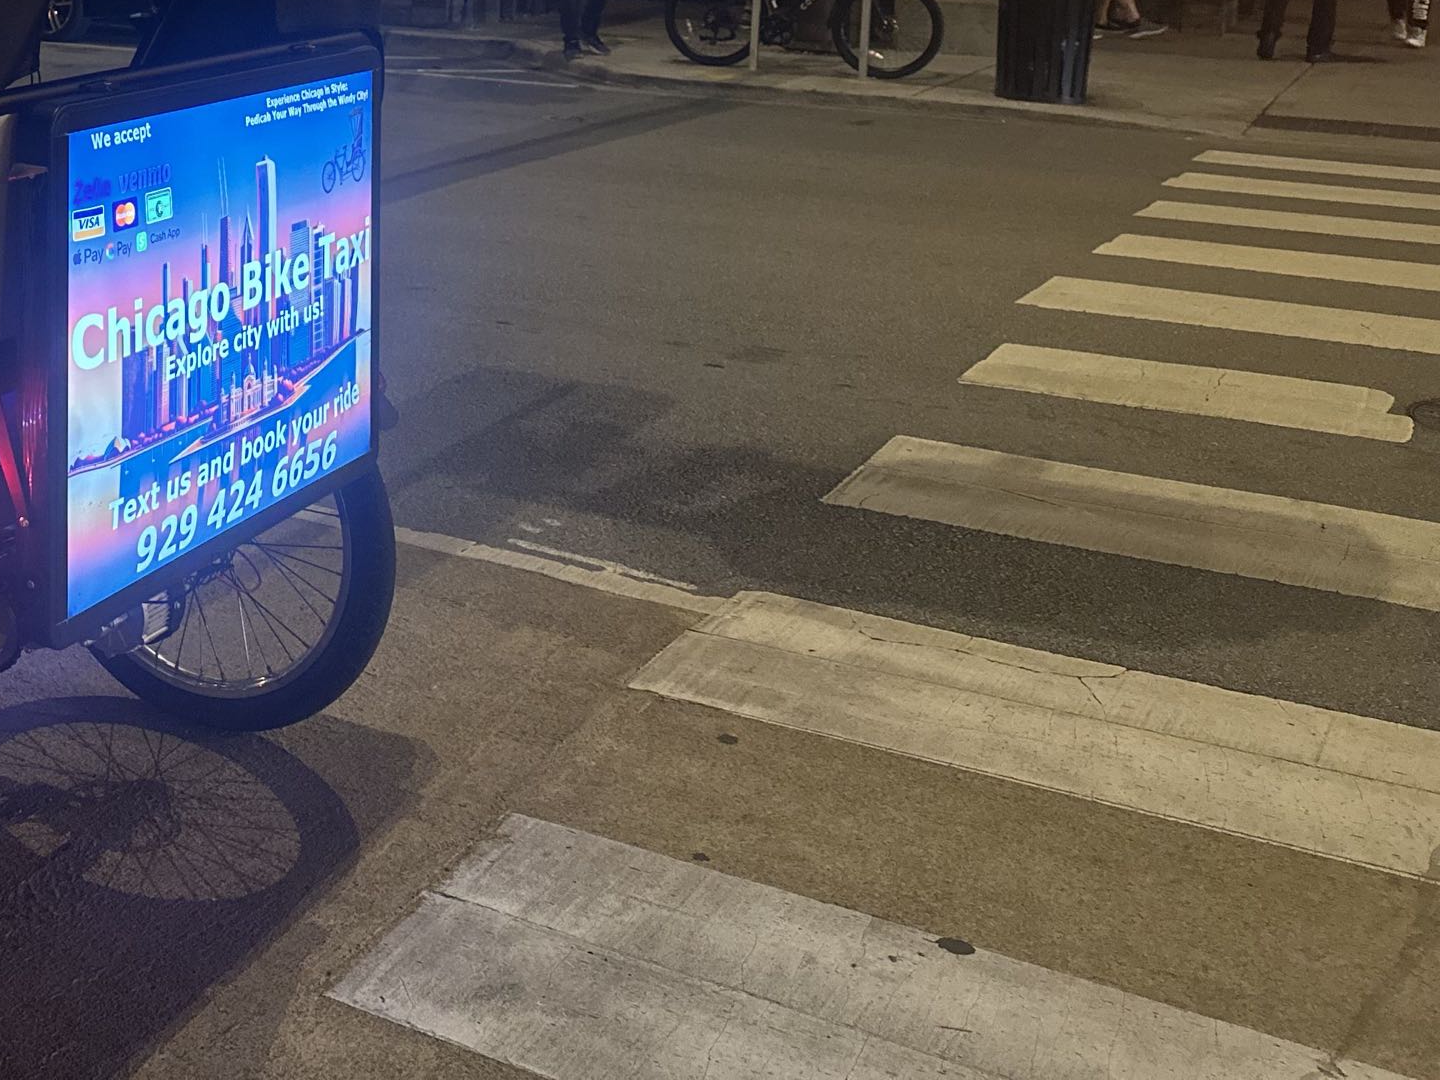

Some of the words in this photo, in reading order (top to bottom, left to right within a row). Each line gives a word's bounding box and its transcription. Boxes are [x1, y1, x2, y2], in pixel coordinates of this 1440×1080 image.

[245, 112, 272, 127] Pedicab
[272, 109, 288, 121] Your
[288, 106, 302, 117] Way
[302, 100, 328, 112] Through
[328, 97, 337, 108] the
[338, 93, 356, 105] Windy
[266, 93, 301, 108] Experience
[301, 87, 324, 101] Chicago
[90, 131, 111, 150] We
[114, 122, 152, 143] accept
[118, 163, 172, 194] venmo
[79, 216, 101, 230] VISA
[150, 231, 167, 244] Cash
[167, 228, 180, 239] App
[84, 248, 105, 264] Pay
[117, 241, 132, 257] Pay
[72, 281, 230, 371] Chicago
[242, 249, 310, 310] Bike
[318, 216, 370, 279] Taxi
[166, 337, 229, 382] Explore
[233, 324, 262, 353] city
[267, 309, 300, 339] with
[303, 295, 324, 323] us!
[109, 482, 166, 531] Text
[166, 469, 191, 500] us
[197, 442, 235, 487] and
[241, 420, 287, 466] book
[291, 404, 330, 446] your
[333, 383, 360, 418] ride
[136, 503, 198, 573] 929
[207, 469, 263, 530] 424
[272, 430, 337, 498] 6656
